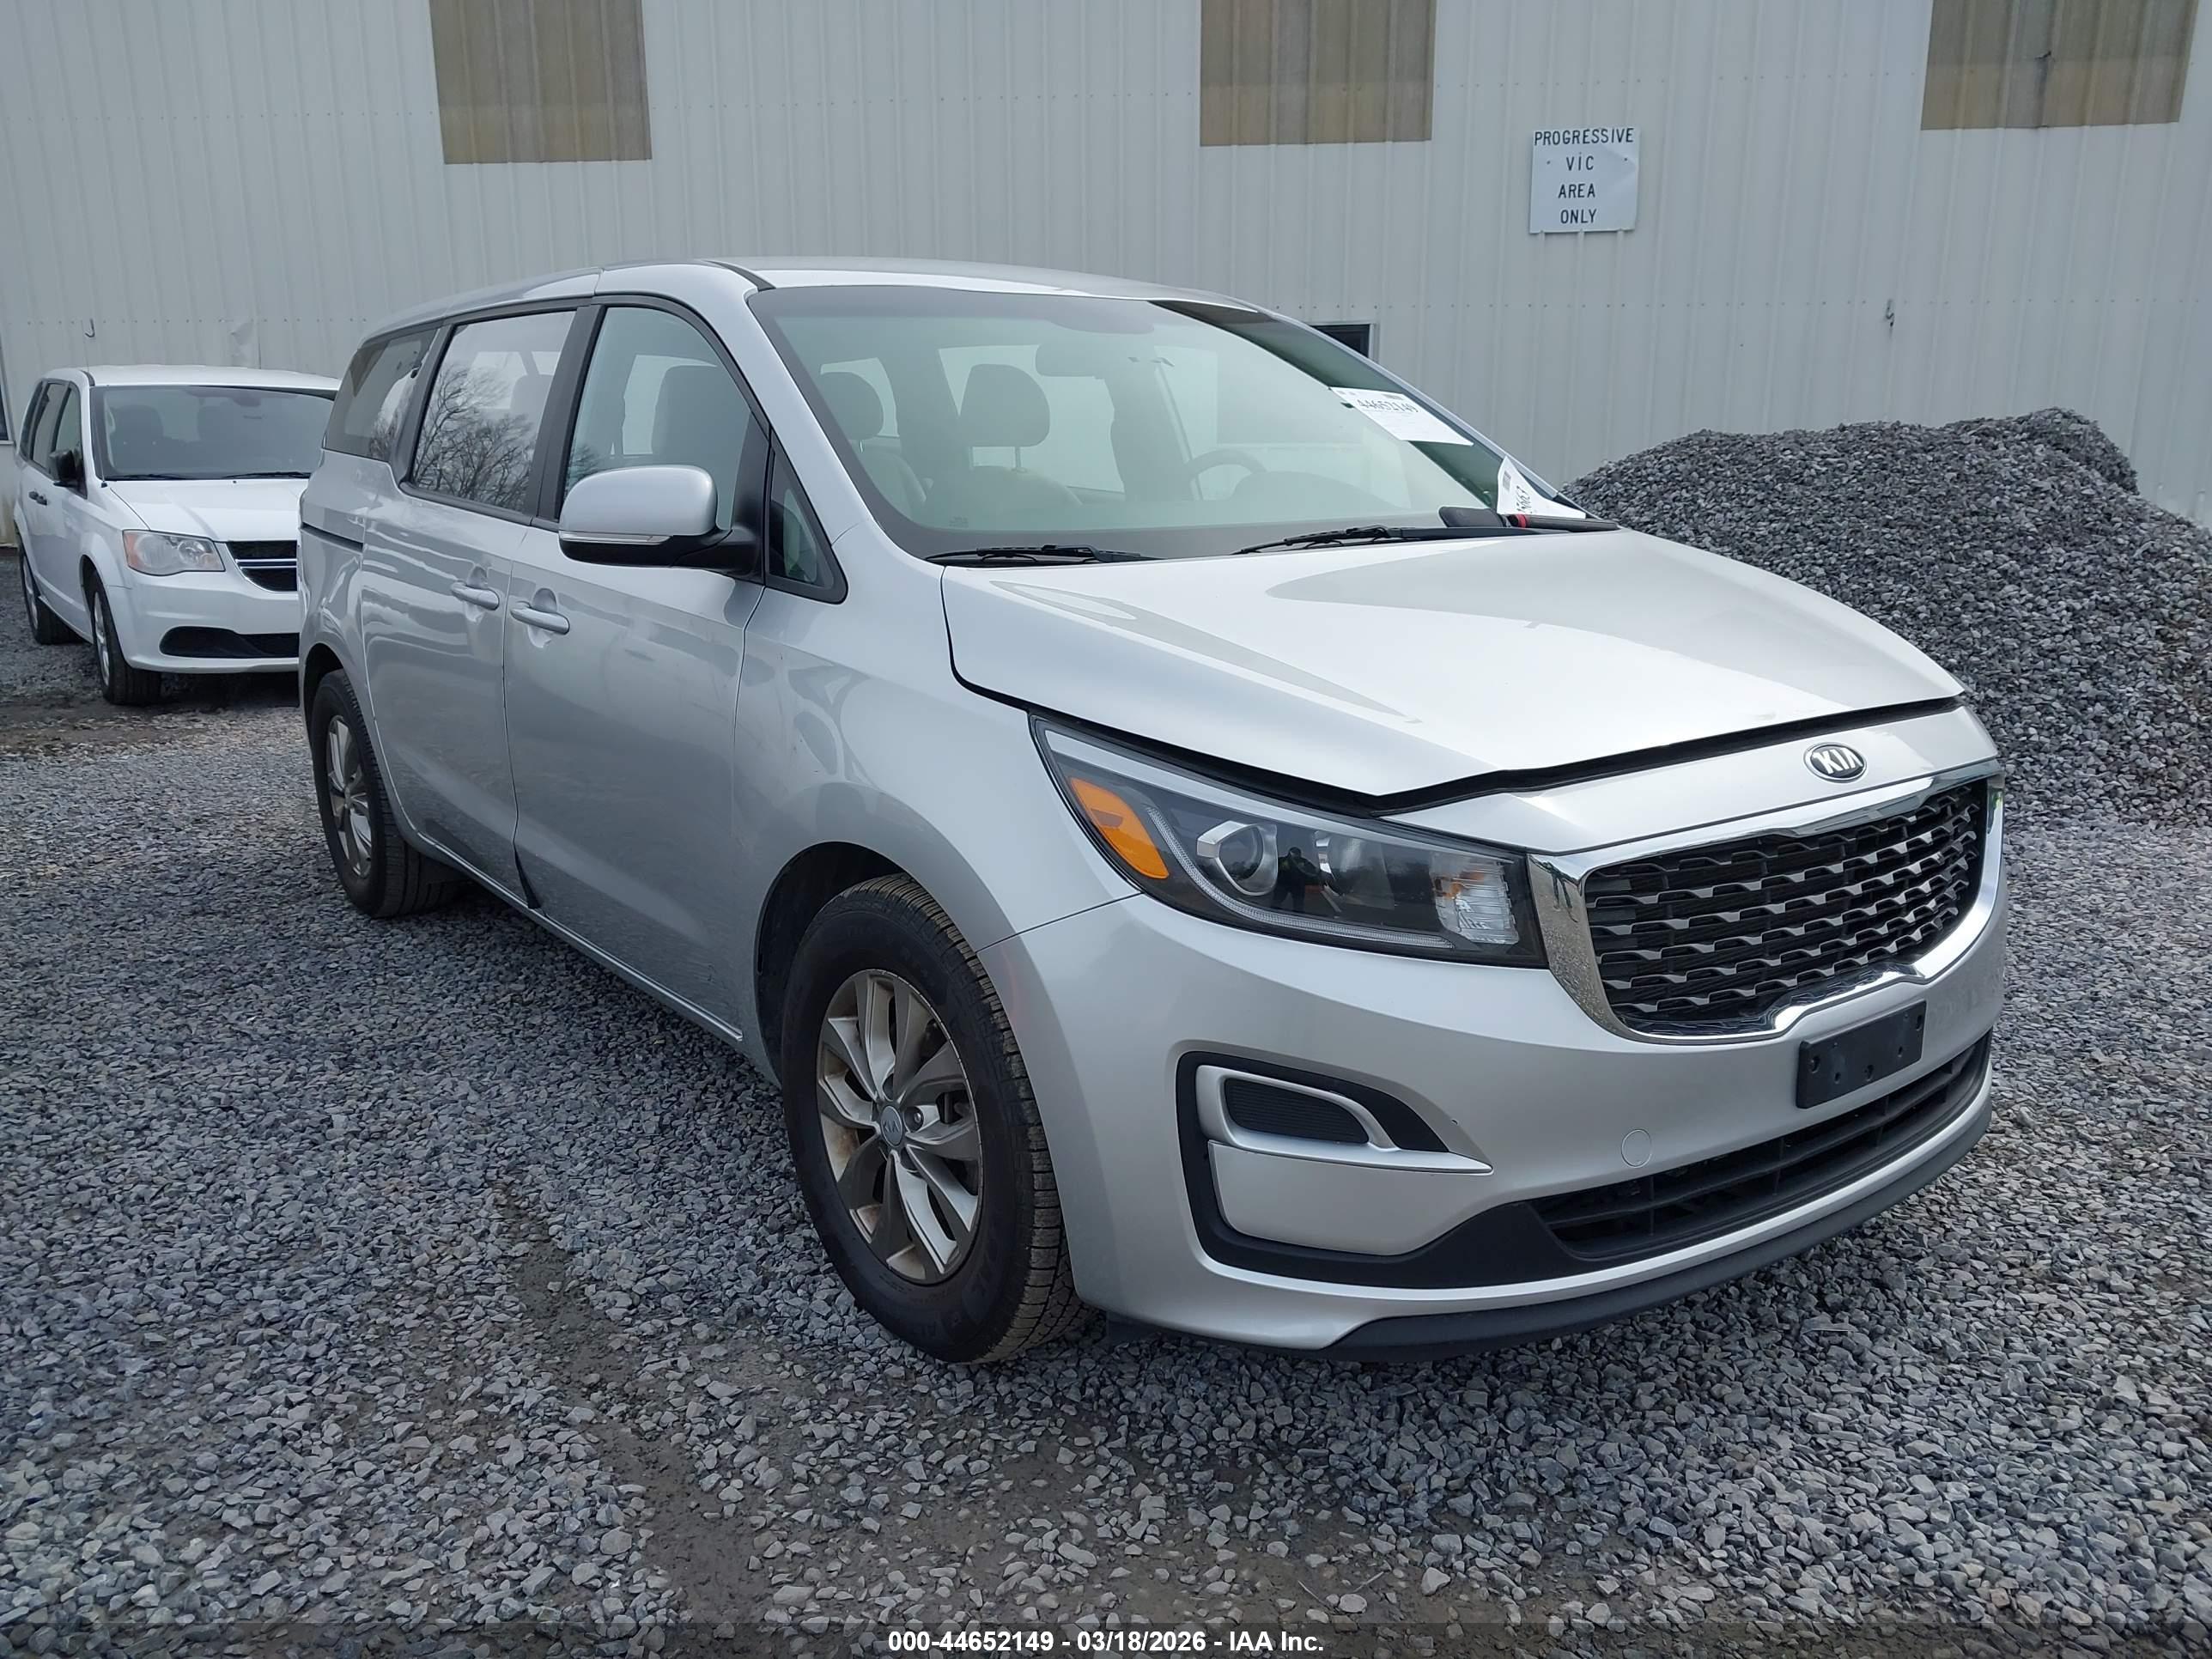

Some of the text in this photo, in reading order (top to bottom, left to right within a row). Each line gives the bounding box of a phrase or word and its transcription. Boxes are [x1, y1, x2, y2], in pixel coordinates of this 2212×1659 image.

[1534, 127, 1634, 146] PROGRESSIVE
[1565, 155, 1595, 171] VIC
[1558, 183, 1596, 199] AREA
[1559, 209, 1597, 224] ONLY
[1811, 747, 1863, 775] KIA
